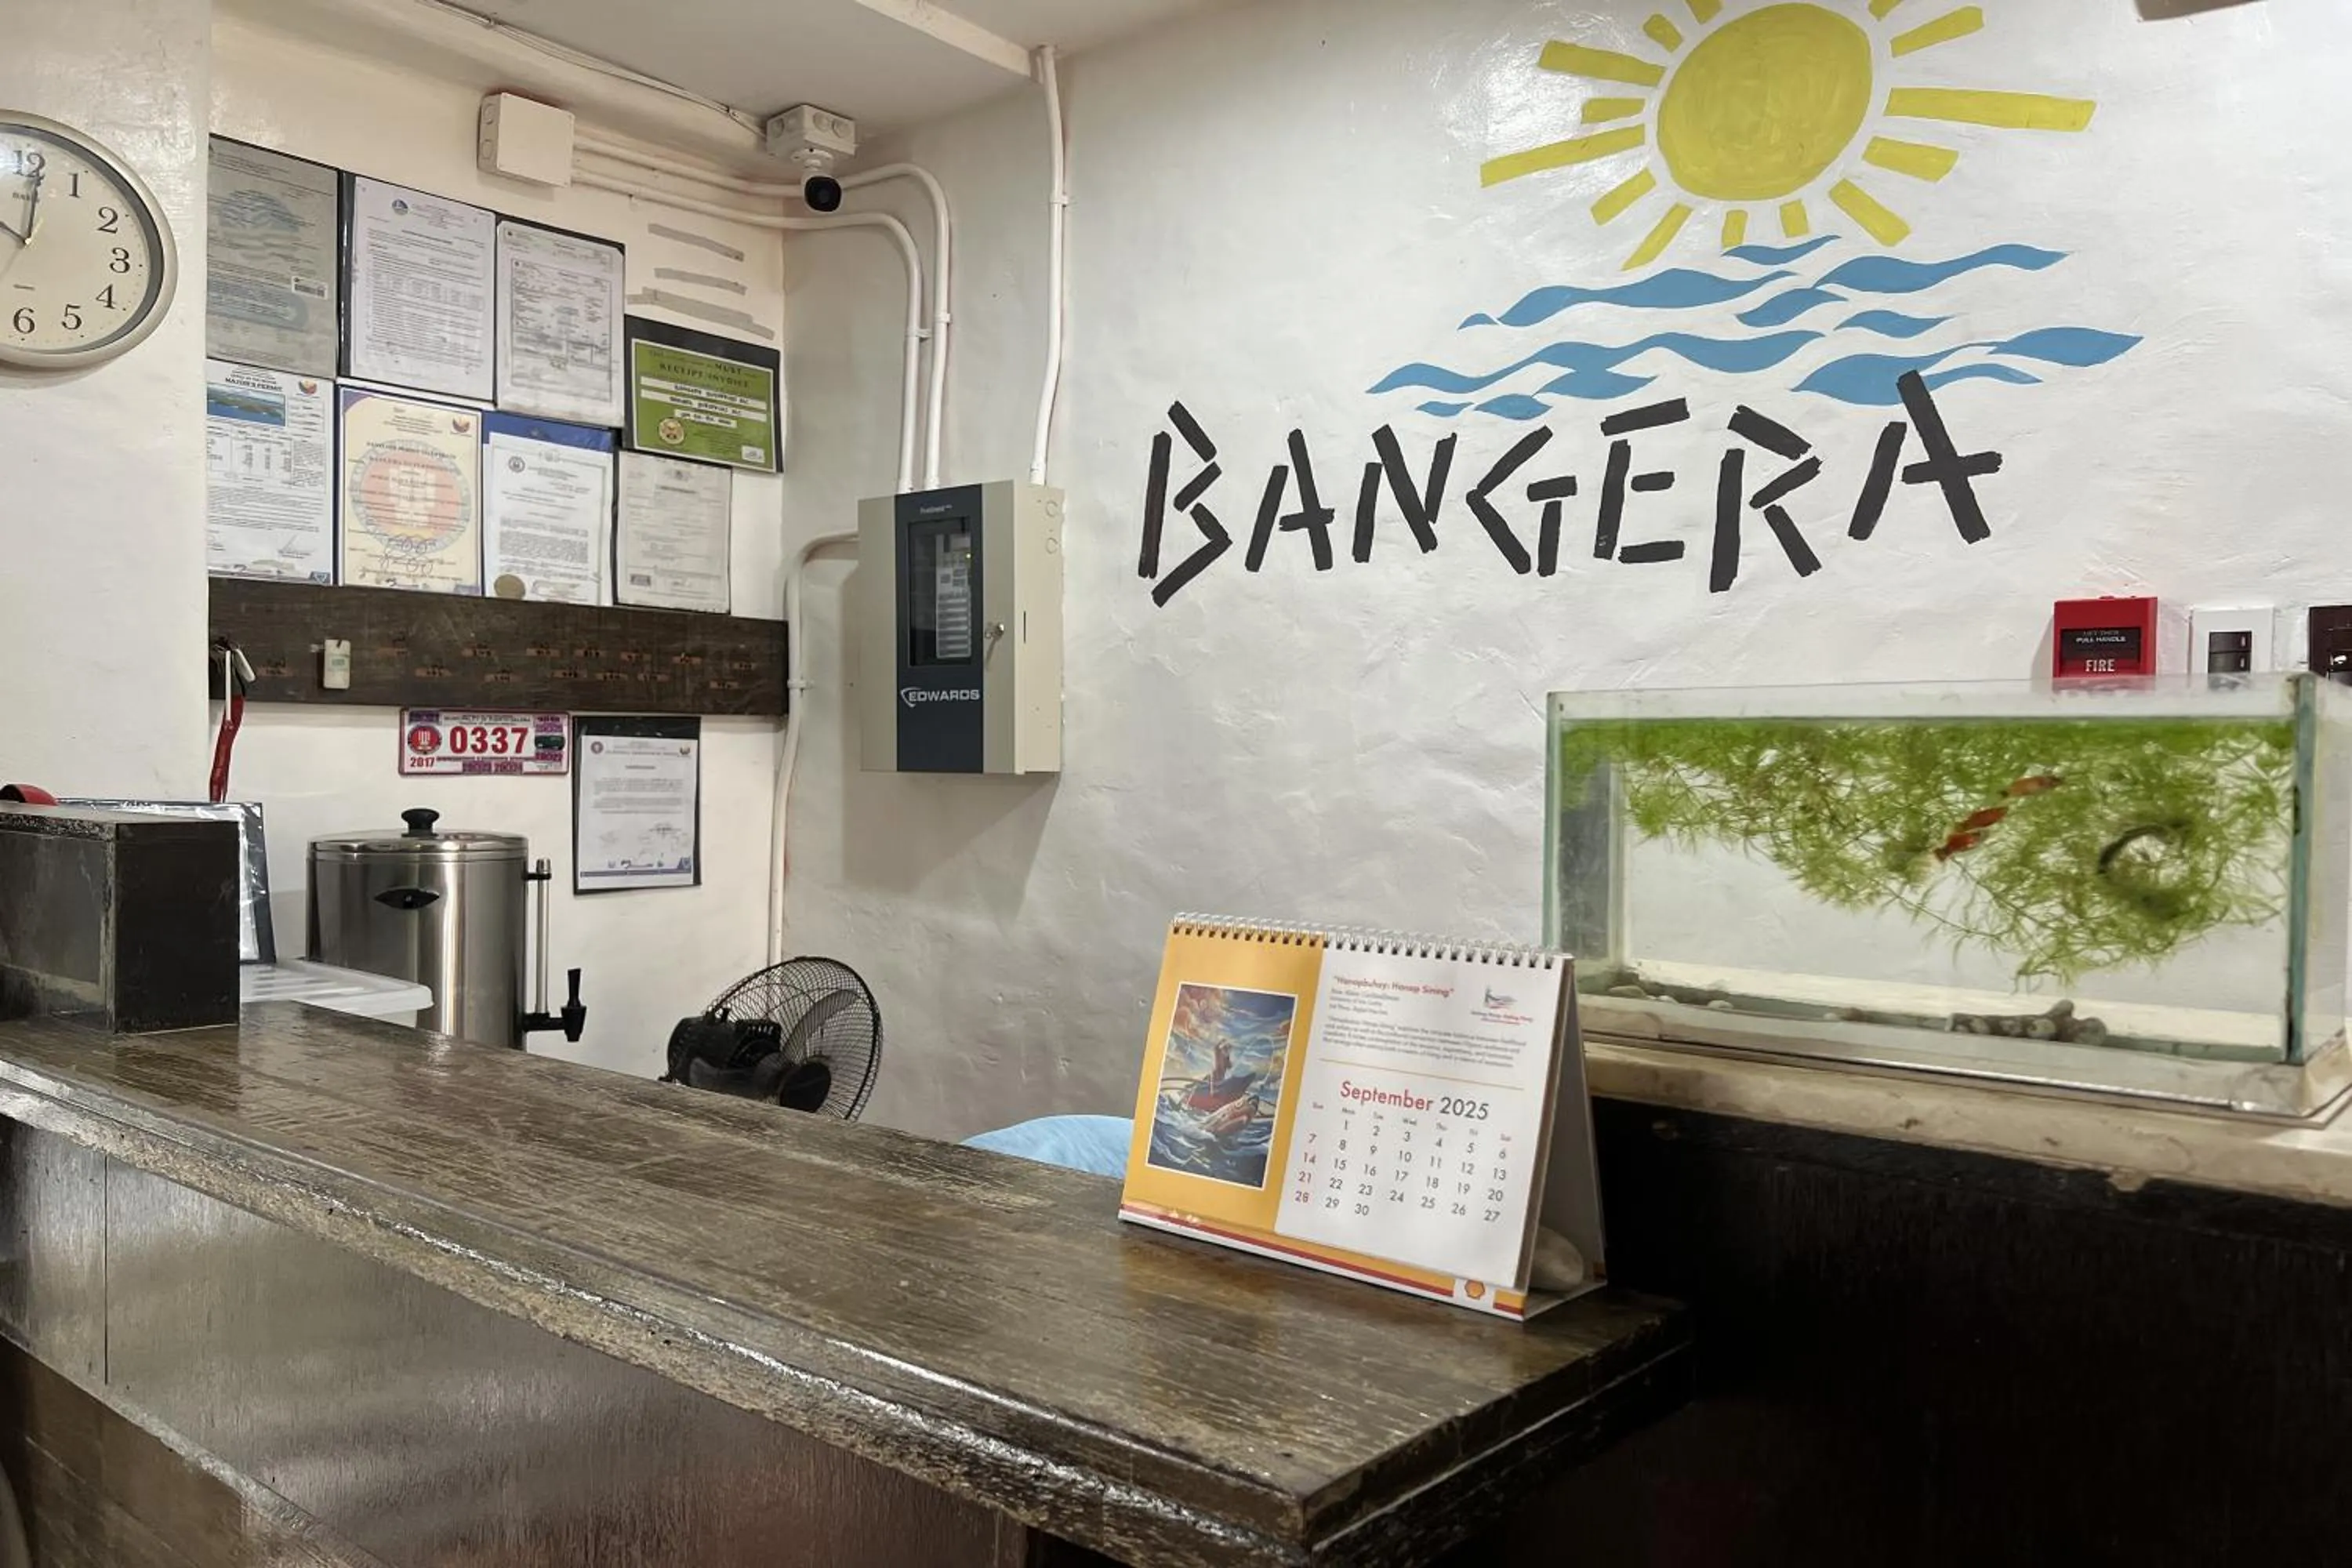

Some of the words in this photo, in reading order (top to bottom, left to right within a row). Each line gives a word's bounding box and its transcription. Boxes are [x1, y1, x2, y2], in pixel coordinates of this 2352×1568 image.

[13, 150, 45, 180] 12
[68, 172, 80, 198] 1
[97, 207, 118, 234] 2
[109, 248, 130, 273] 3
[96, 284, 116, 309] 4
[13, 307, 35, 333] 6
[61, 304, 82, 330] 5
[1138, 370, 2002, 608] BANGERA
[2085, 659, 2115, 672] FIRE
[909, 689, 981, 703] EDWARDS
[449, 725, 529, 754] 0337
[410, 757, 435, 768] 2017
[1340, 1080, 1434, 1111] September
[1439, 1096, 1490, 1120] 2025
[1344, 1119, 1348, 1131] 1
[1372, 1125, 1381, 1136] 2
[1403, 1131, 1410, 1142] 3
[1435, 1138, 1443, 1148] 4
[1467, 1142, 1475, 1154] 5
[1498, 1148, 1506, 1160] 6
[1308, 1133, 1317, 1143] 7
[1338, 1138, 1347, 1151] 8
[1370, 1145, 1377, 1155] 9
[1399, 1150, 1412, 1163] 10
[1430, 1155, 1442, 1169] 11
[1461, 1162, 1475, 1175] 12
[1494, 1167, 1506, 1181] 13
[1304, 1152, 1316, 1164] 14
[1334, 1158, 1347, 1171] 15
[1364, 1163, 1377, 1177] 16
[1395, 1169, 1409, 1181] 17
[1426, 1175, 1439, 1189] 18
[1457, 1181, 1471, 1194] 19
[1487, 1188, 1504, 1202] 20
[1295, 1191, 1310, 1203] 28
[1325, 1196, 1340, 1208] 29
[1354, 1203, 1370, 1216] 30
[1298, 1171, 1312, 1184] 21
[1329, 1177, 1343, 1189] 22
[1358, 1183, 1373, 1196] 23
[1389, 1189, 1404, 1203] 24
[1421, 1196, 1436, 1209] 25
[1451, 1202, 1466, 1216] 26
[1483, 1209, 1501, 1221] 27
